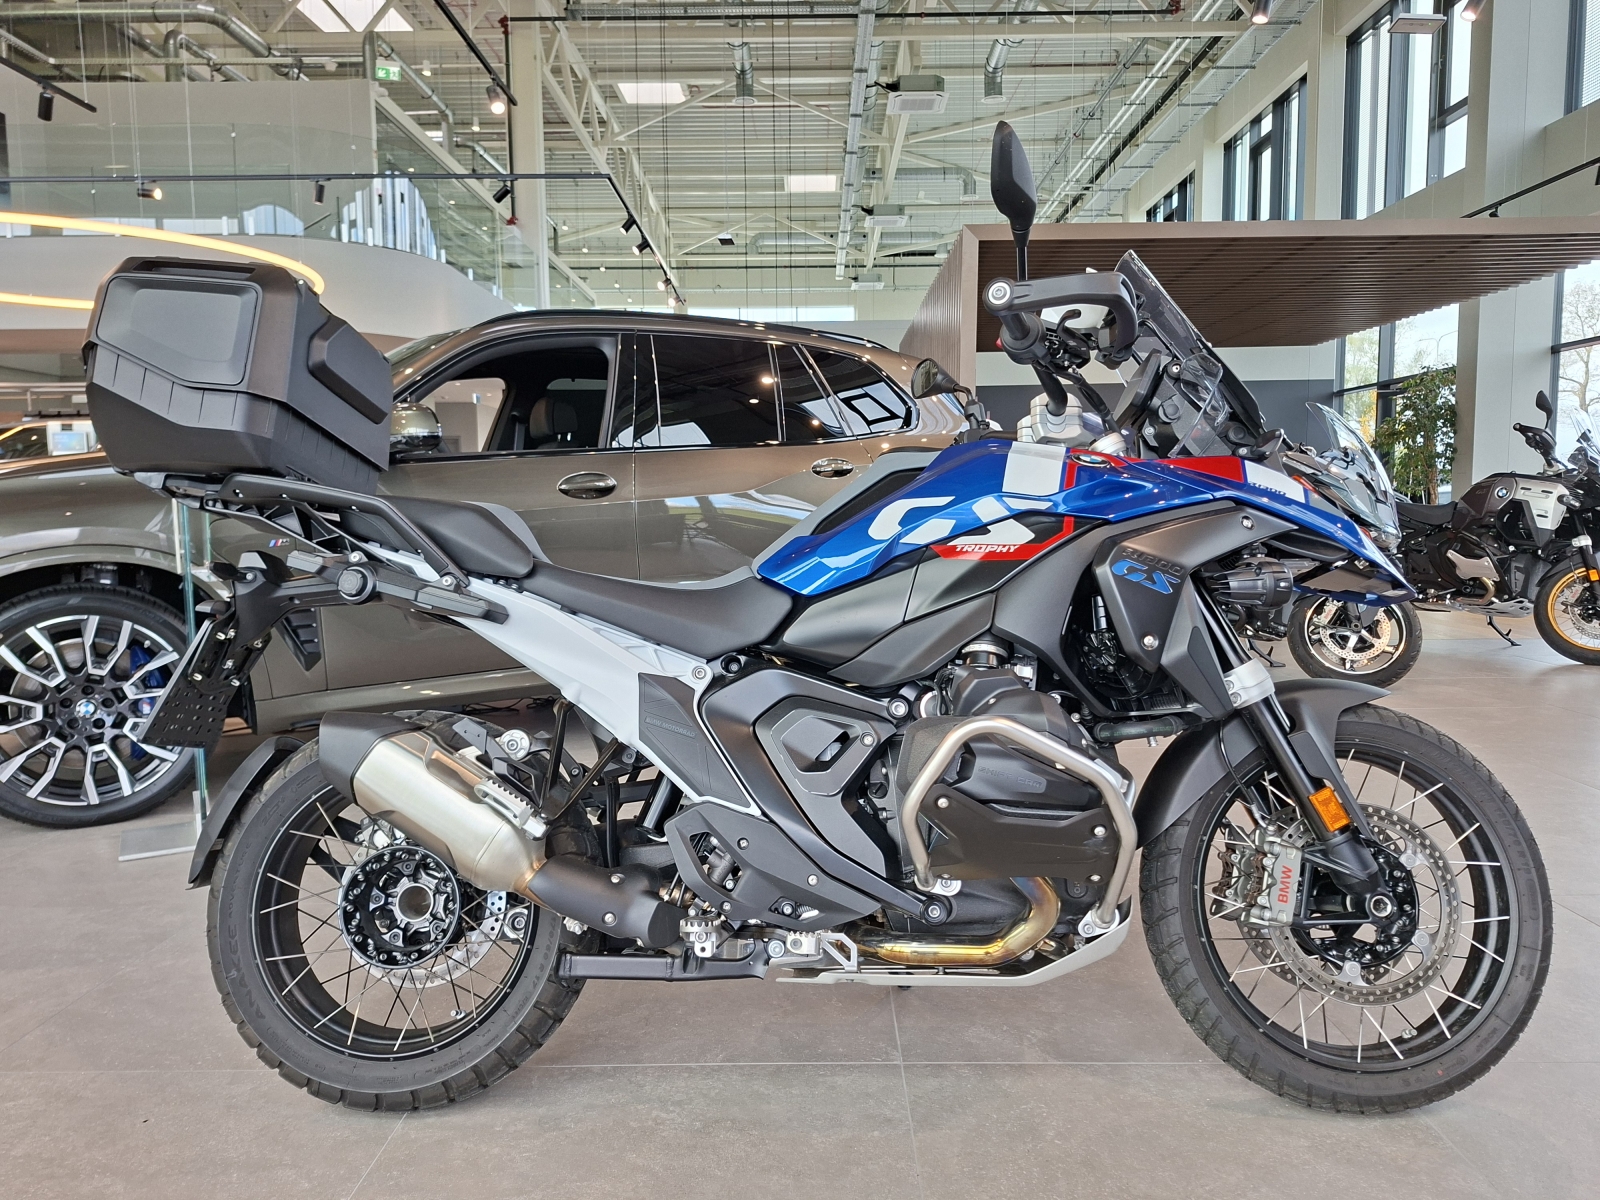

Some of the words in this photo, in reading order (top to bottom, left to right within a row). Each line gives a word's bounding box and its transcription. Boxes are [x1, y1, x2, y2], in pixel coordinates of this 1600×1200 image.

[868, 495, 1053, 545] GS
[955, 544, 1020, 553] TROPHY
[1111, 558, 1181, 594] GS
[662, 722, 696, 738] MOTORRAD
[1277, 865, 1293, 904] BMW
[228, 923, 267, 1020] ANAKEE
